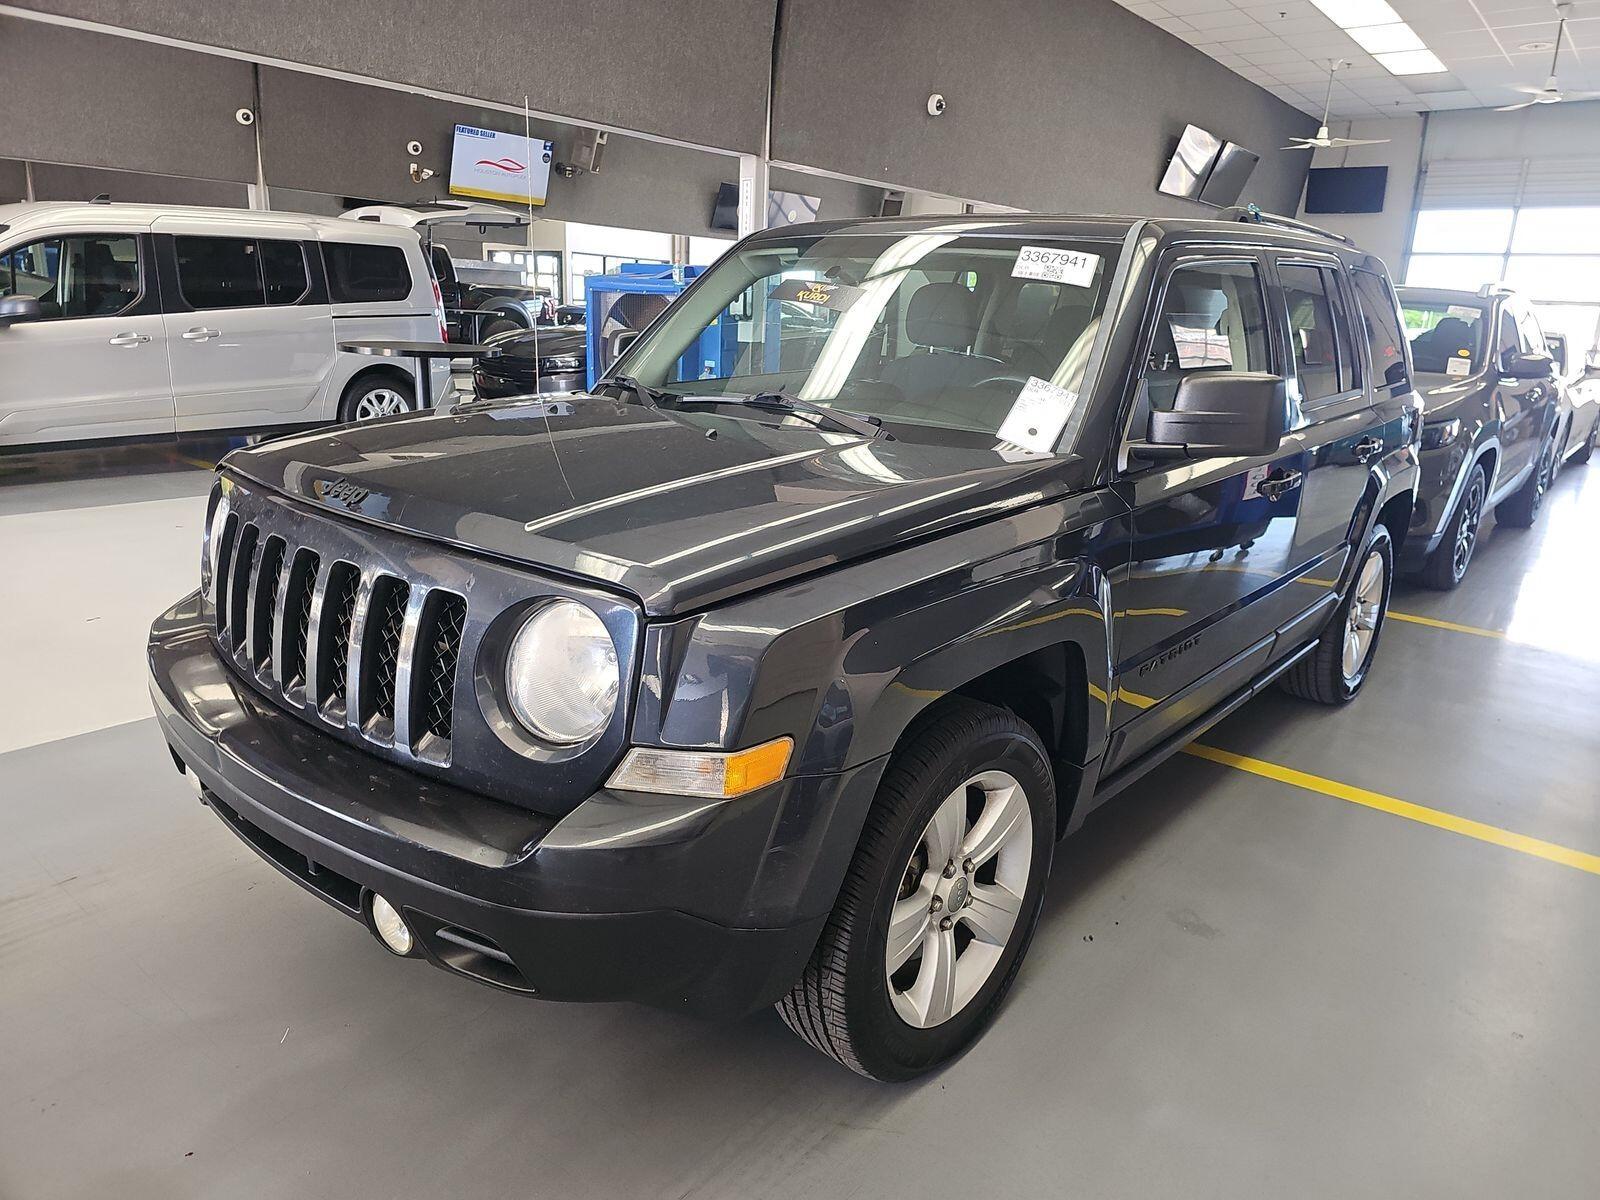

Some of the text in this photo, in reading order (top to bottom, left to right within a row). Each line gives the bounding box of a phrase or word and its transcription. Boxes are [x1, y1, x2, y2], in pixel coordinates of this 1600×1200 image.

[456, 126, 496, 139] FEATURED SELLER
[1021, 250, 1088, 269] 3367941
[321, 477, 369, 507] Jeep
[1138, 633, 1202, 677] PATRIOT
